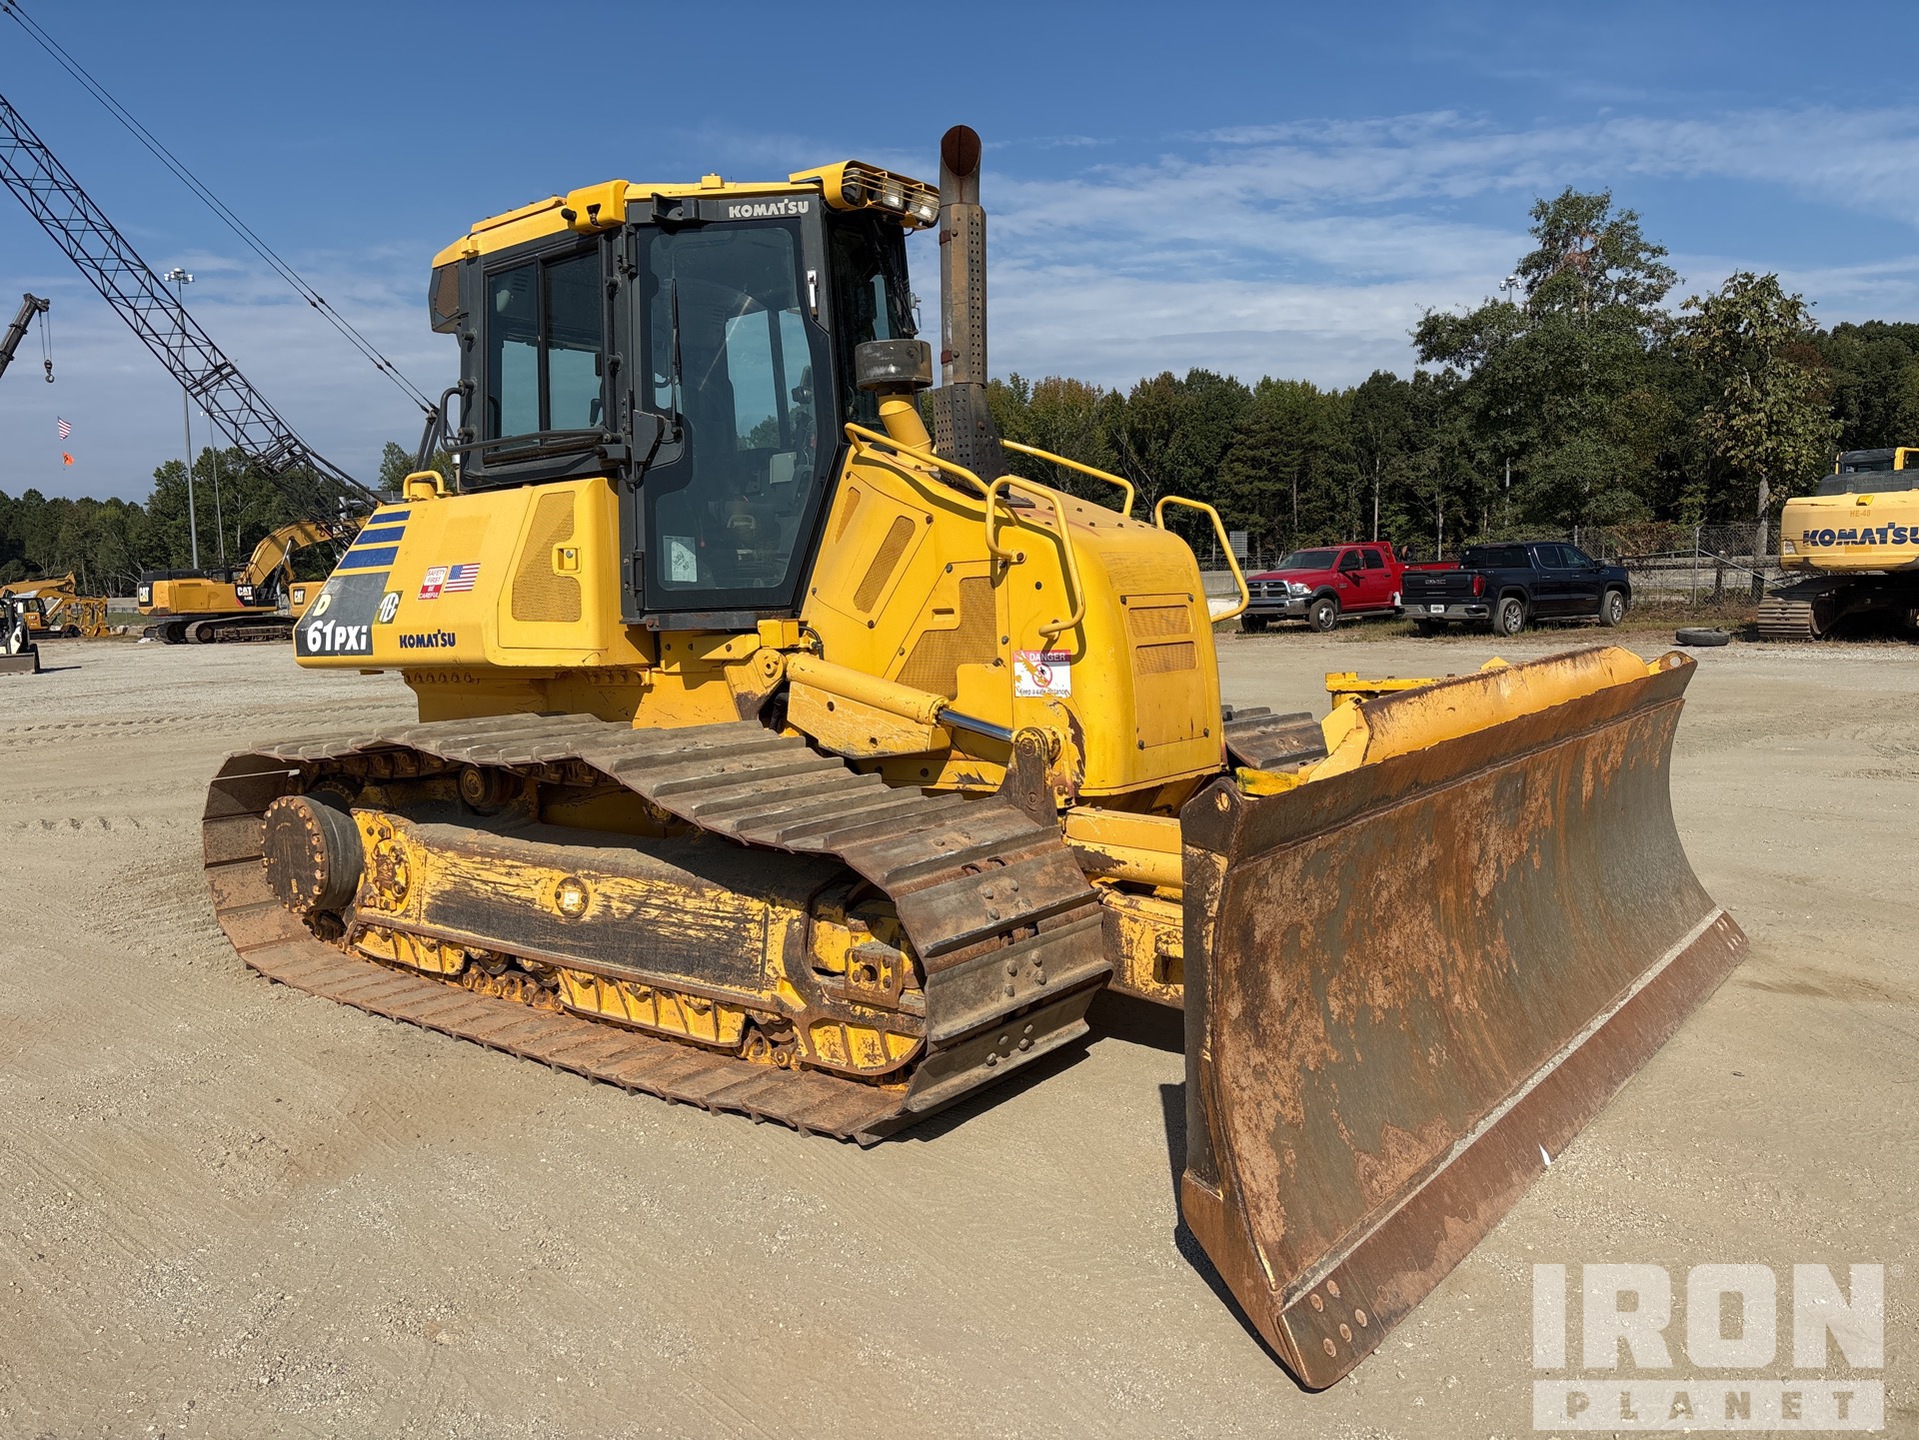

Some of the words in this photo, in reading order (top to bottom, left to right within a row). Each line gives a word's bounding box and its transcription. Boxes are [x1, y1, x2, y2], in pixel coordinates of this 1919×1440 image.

[728, 199, 809, 218] KOMATSU
[427, 569, 446, 577] SAFETY
[138, 587, 149, 602] CAT
[237, 586, 252, 596] CAT
[294, 590, 304, 602] CAT
[312, 594, 332, 617] D
[307, 619, 368, 652] 61PXi
[399, 629, 456, 648] KOMATSU
[1029, 653, 1066, 661] DANGER
